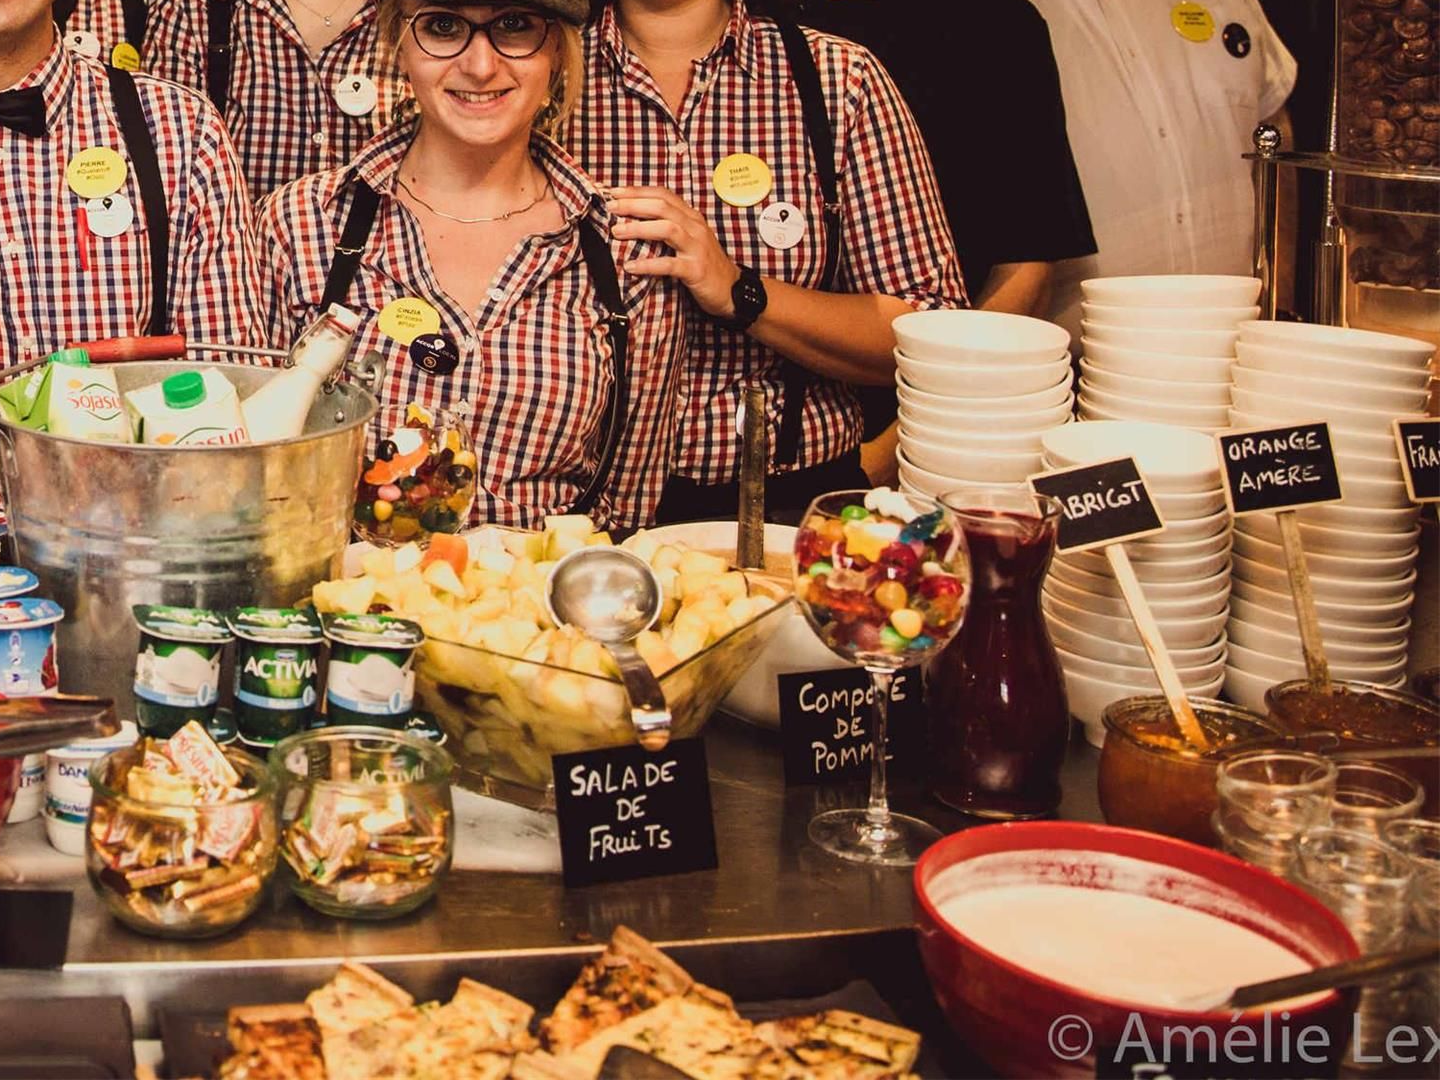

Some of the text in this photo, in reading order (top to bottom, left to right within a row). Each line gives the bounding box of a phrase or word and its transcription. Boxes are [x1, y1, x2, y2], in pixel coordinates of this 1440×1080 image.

[1227, 430, 1322, 459] ORANGE
[244, 655, 317, 680] ACTIVIA
[833, 716, 866, 740] DE
[569, 760, 679, 798] SALADE
[616, 797, 647, 822] DE
